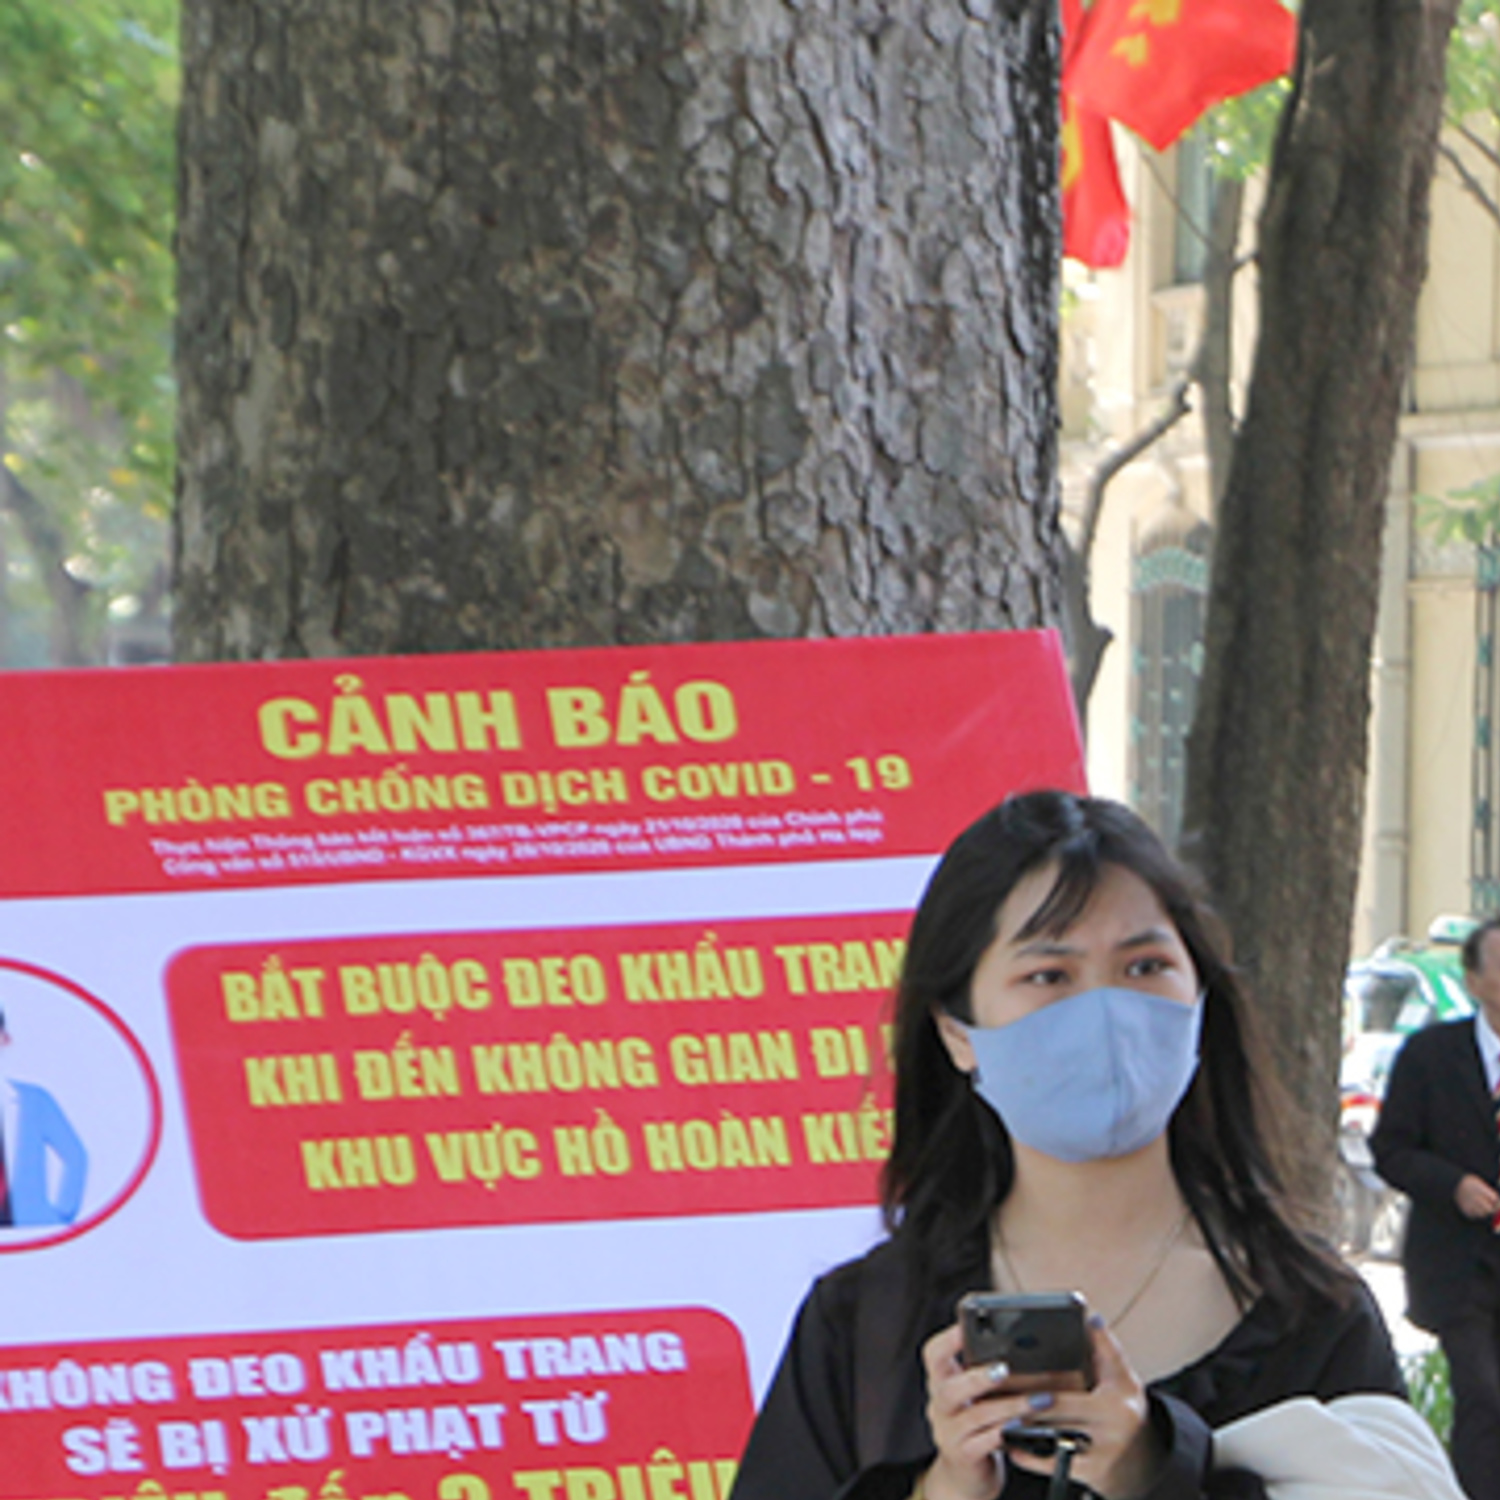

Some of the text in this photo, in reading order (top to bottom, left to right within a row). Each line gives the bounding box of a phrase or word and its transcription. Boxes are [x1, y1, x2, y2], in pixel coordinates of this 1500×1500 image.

[259, 671, 737, 759] CẢNH BÁO
[104, 755, 911, 825] PHÒNG CHỐNG DỊCH COVID - 19
[340, 953, 492, 1020] BUỘC
[502, 955, 607, 1007] ĐEO
[619, 932, 764, 1002] KHẨU
[774, 939, 906, 994] TRAN
[245, 1053, 342, 1106] KHI
[354, 1032, 461, 1100] ĐẾN
[472, 1033, 659, 1094] KHÔNG
[670, 1030, 799, 1085] GIAN
[810, 1026, 870, 1078] ĐI
[301, 1135, 416, 1190] KHU
[425, 1123, 542, 1189] VỰC
[643, 1111, 792, 1171] HOÀN
[802, 1094, 893, 1163] KIẾ
[0, 1360, 173, 1409] HÔNG
[189, 1354, 304, 1397] ĐEO
[494, 1332, 685, 1378] TRANG
[63, 1391, 607, 1473] SẼ BỊ XỬ PHẠT TỪ
